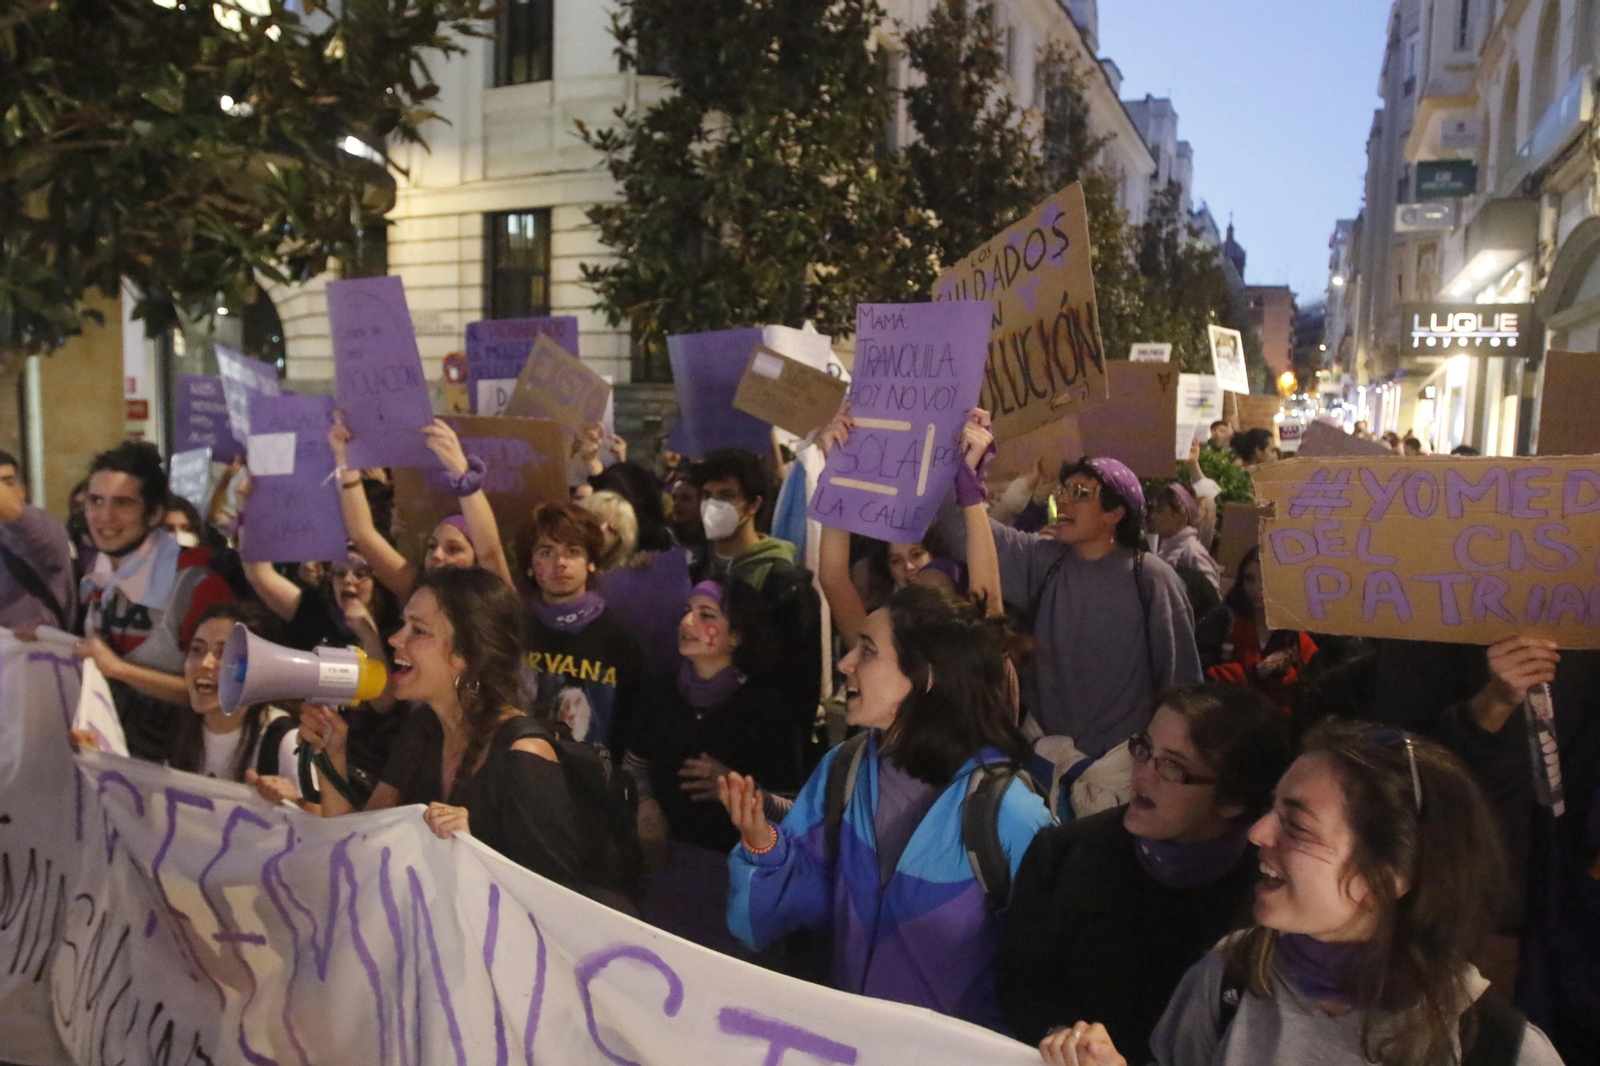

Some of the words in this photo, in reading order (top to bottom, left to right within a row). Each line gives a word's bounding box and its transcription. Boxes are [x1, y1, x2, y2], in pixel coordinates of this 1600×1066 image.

[936, 211, 1070, 302] UIDADOS
[1412, 312, 1519, 333] LUQUE
[886, 383, 917, 411] NO
[923, 383, 960, 411] VOY
[833, 429, 921, 479] SOLA
[932, 445, 961, 468] PO
[814, 485, 845, 518] LA
[859, 500, 925, 531] CALLE
[1268, 520, 1398, 566] DEL
